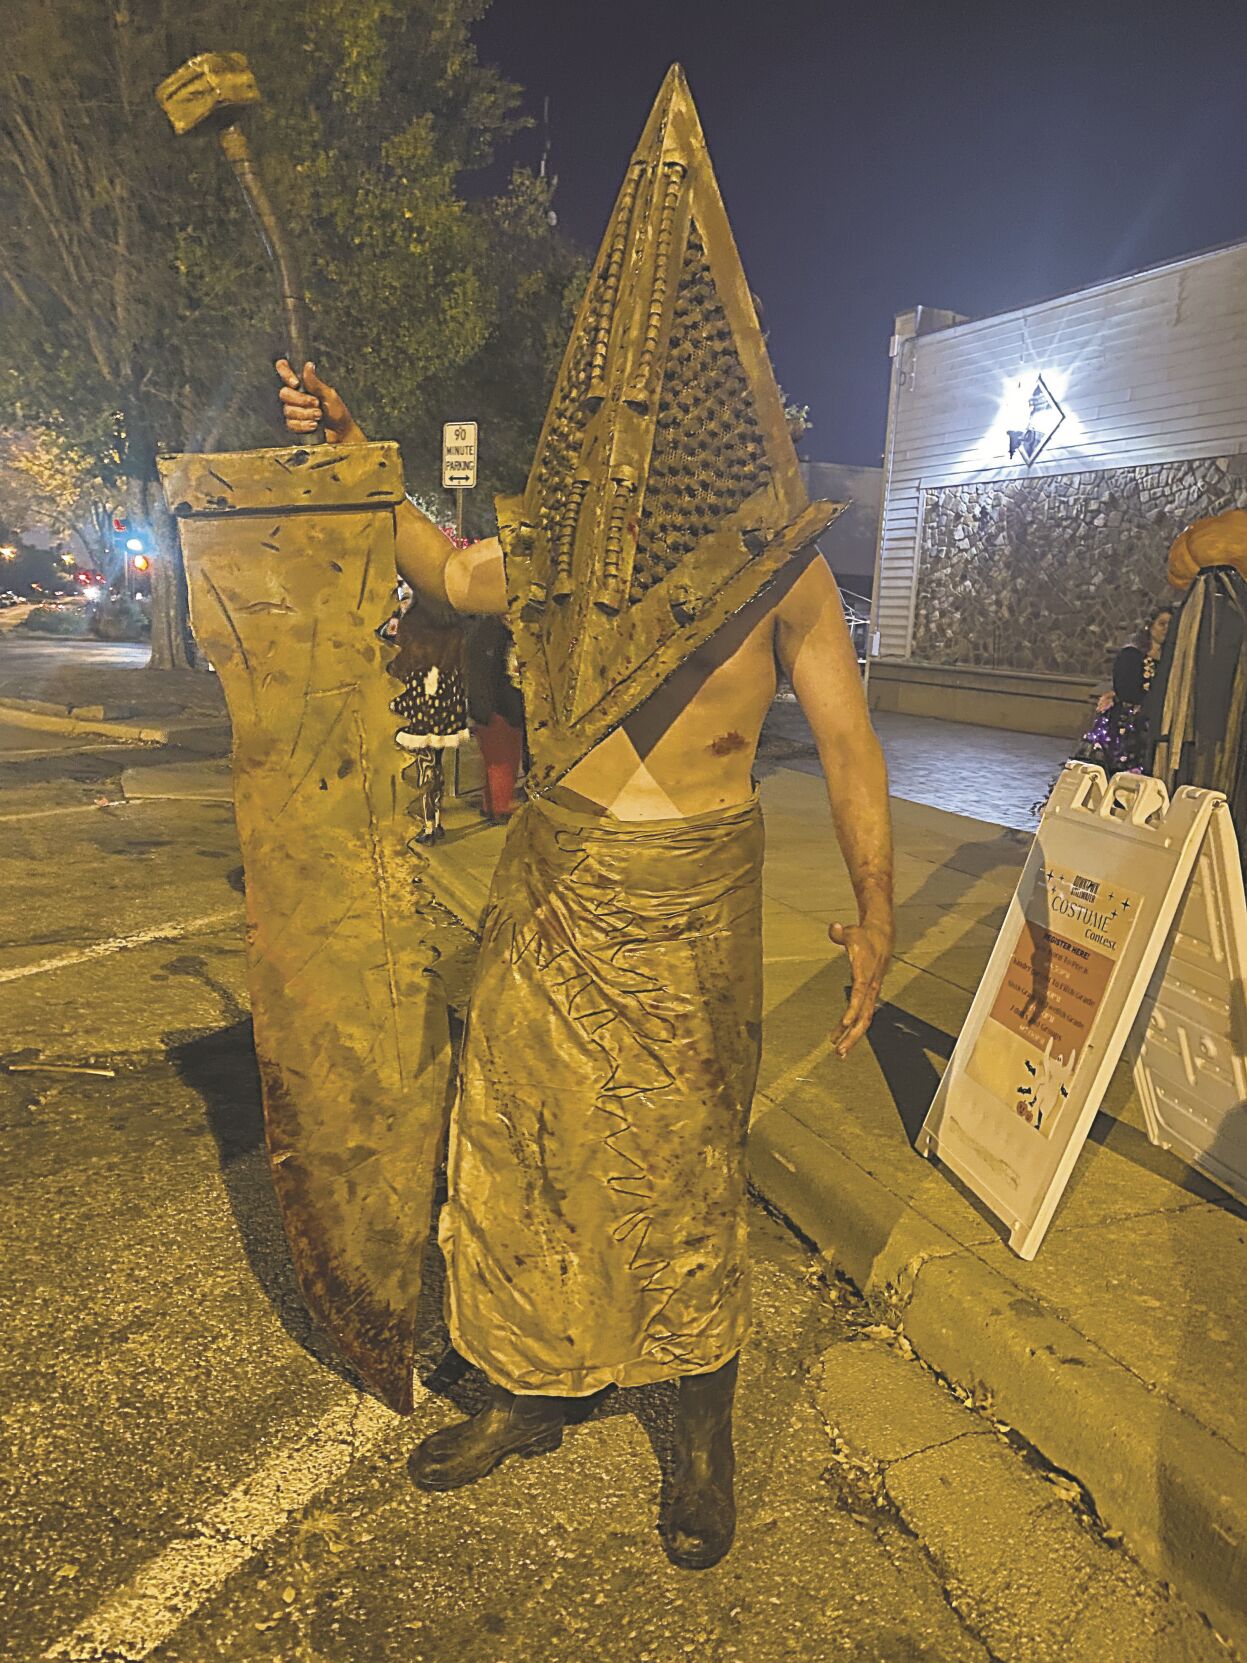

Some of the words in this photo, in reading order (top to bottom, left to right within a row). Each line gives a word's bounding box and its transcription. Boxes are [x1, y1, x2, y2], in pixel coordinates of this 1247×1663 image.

[454, 428, 467, 441] 90
[446, 445, 474, 456] MINUTE
[445, 460, 475, 471] PARKING
[1051, 895, 1111, 933] COSTUME
[1044, 932, 1073, 951] REGISTER
[1084, 929, 1117, 951] Contest
